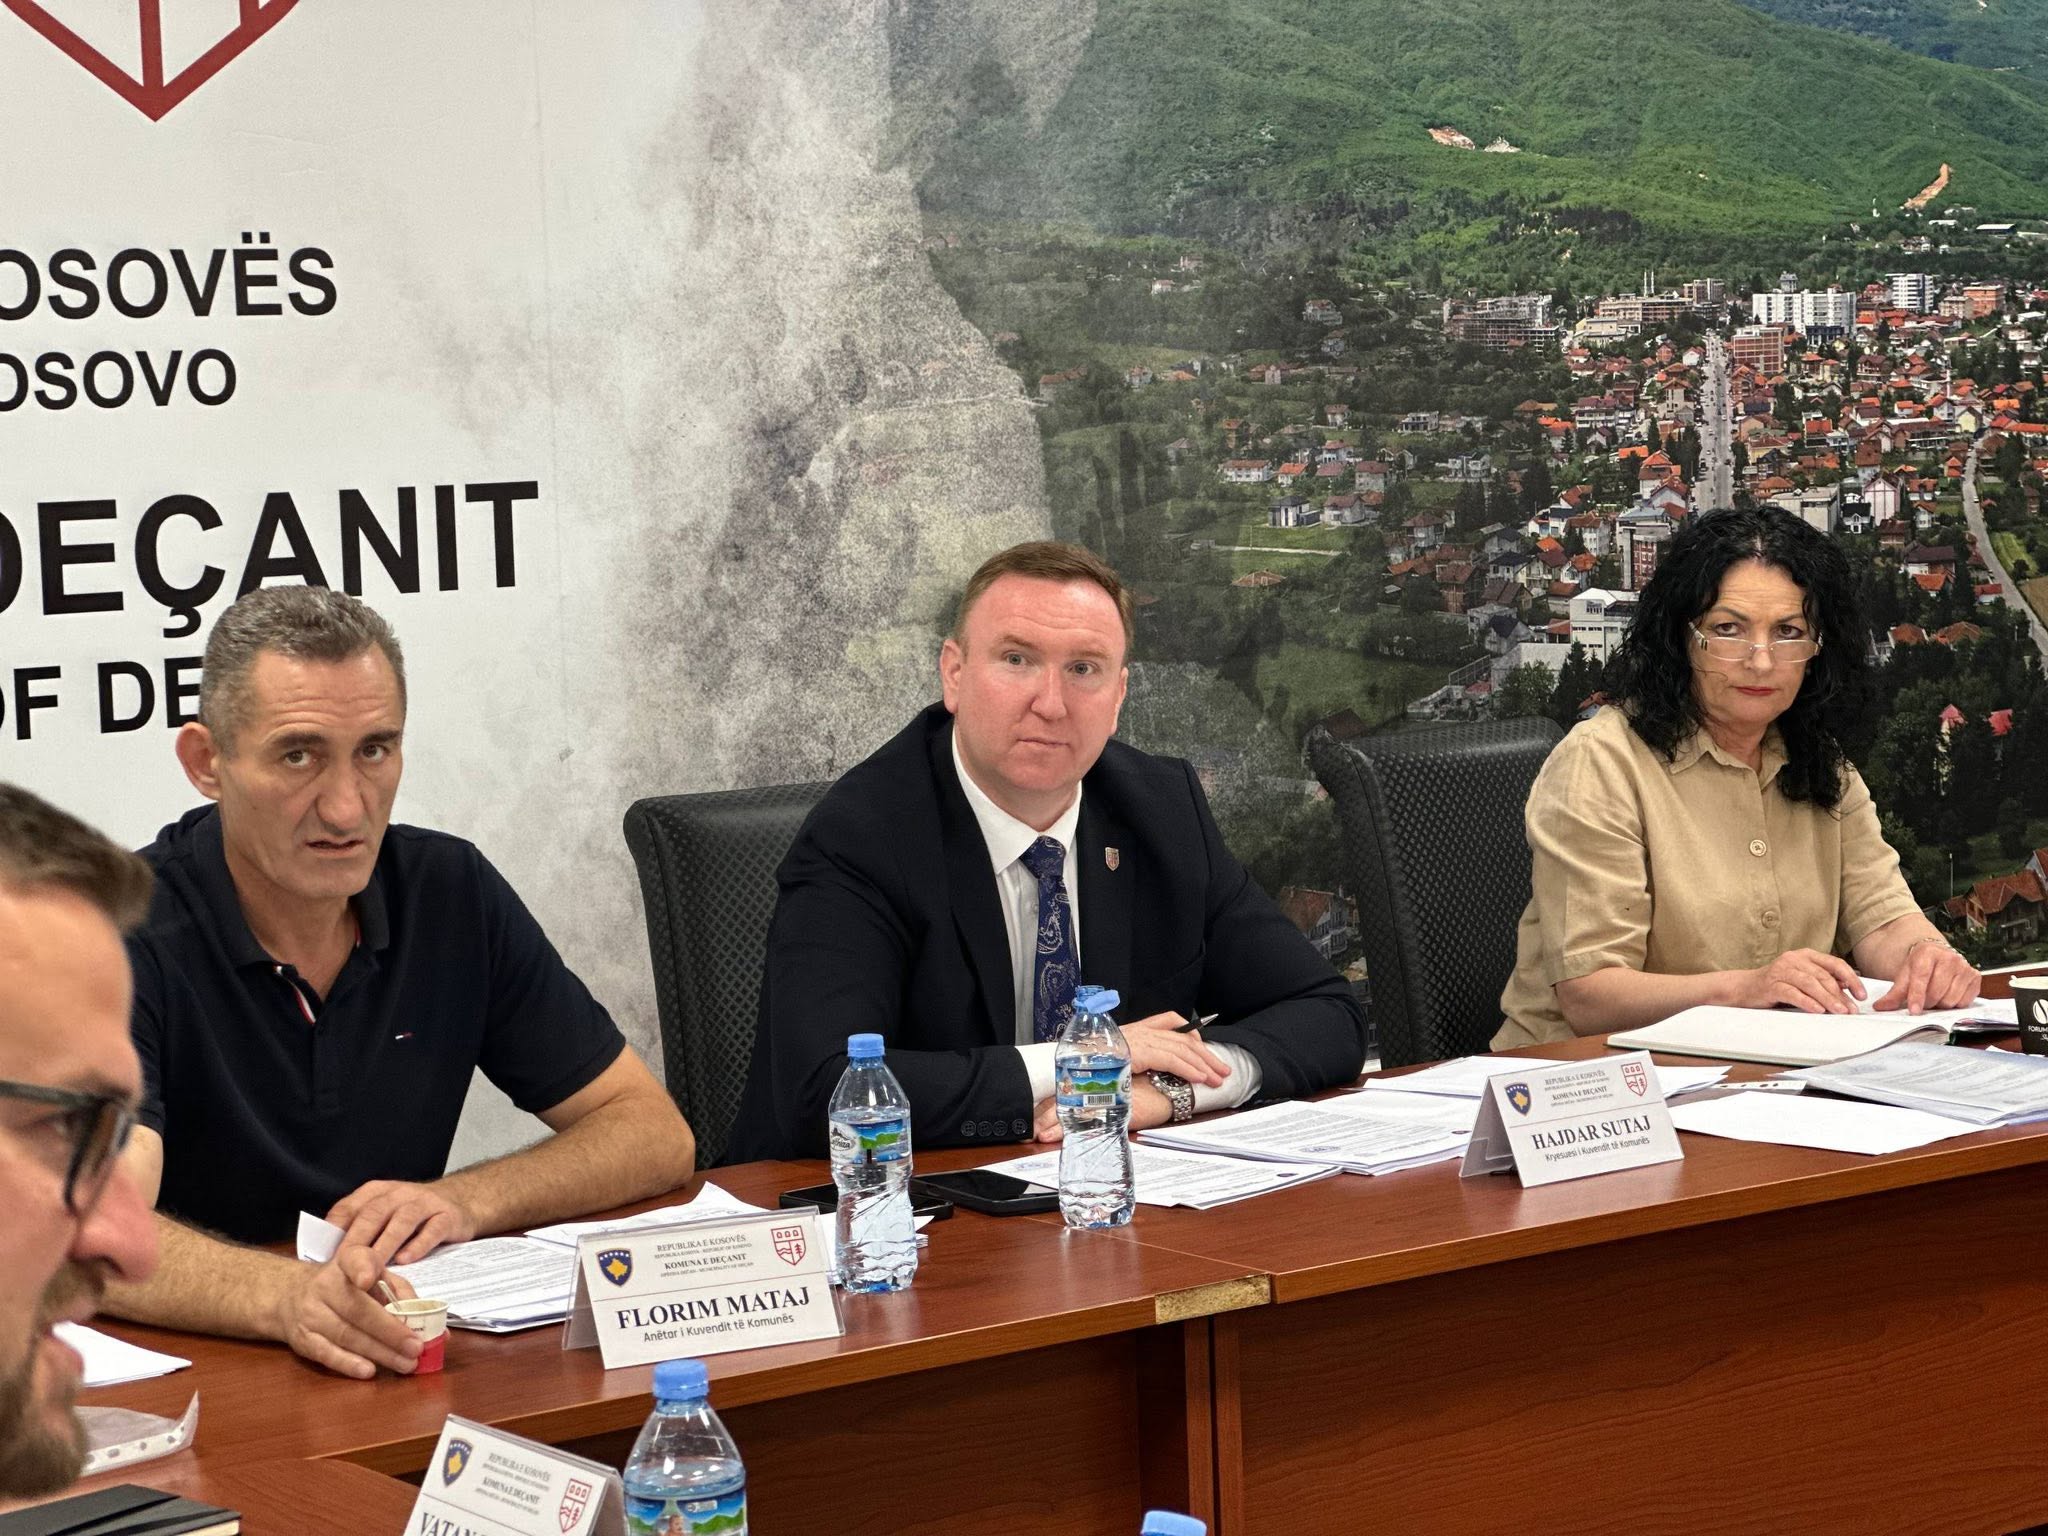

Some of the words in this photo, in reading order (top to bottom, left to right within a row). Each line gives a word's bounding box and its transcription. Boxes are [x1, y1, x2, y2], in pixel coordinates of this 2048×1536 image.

[0, 480, 539, 639] EÇANIT
[0, 665, 62, 741] F
[1531, 1124, 1601, 1150] HAJDAR
[1601, 1115, 1651, 1138] SUTAJ
[1545, 1150, 1578, 1162] Kryesuesi
[1582, 1143, 1610, 1155] Kuvendit
[1611, 1142, 1620, 1150] të
[1620, 1136, 1650, 1148] Komunës
[657, 1241, 702, 1252] REPUBLIKA
[703, 1239, 710, 1247] E
[710, 1234, 746, 1246] KOSOVËS
[664, 1259, 702, 1270] KOMUNA
[710, 1253, 746, 1264] DEÇANIT
[616, 1298, 720, 1329] FLORIM
[726, 1287, 810, 1314] MATAJ
[644, 1329, 678, 1343] Anëtar
[686, 1322, 732, 1336] Kuvendit
[733, 1320, 745, 1330] të
[747, 1313, 794, 1328] Komunës
